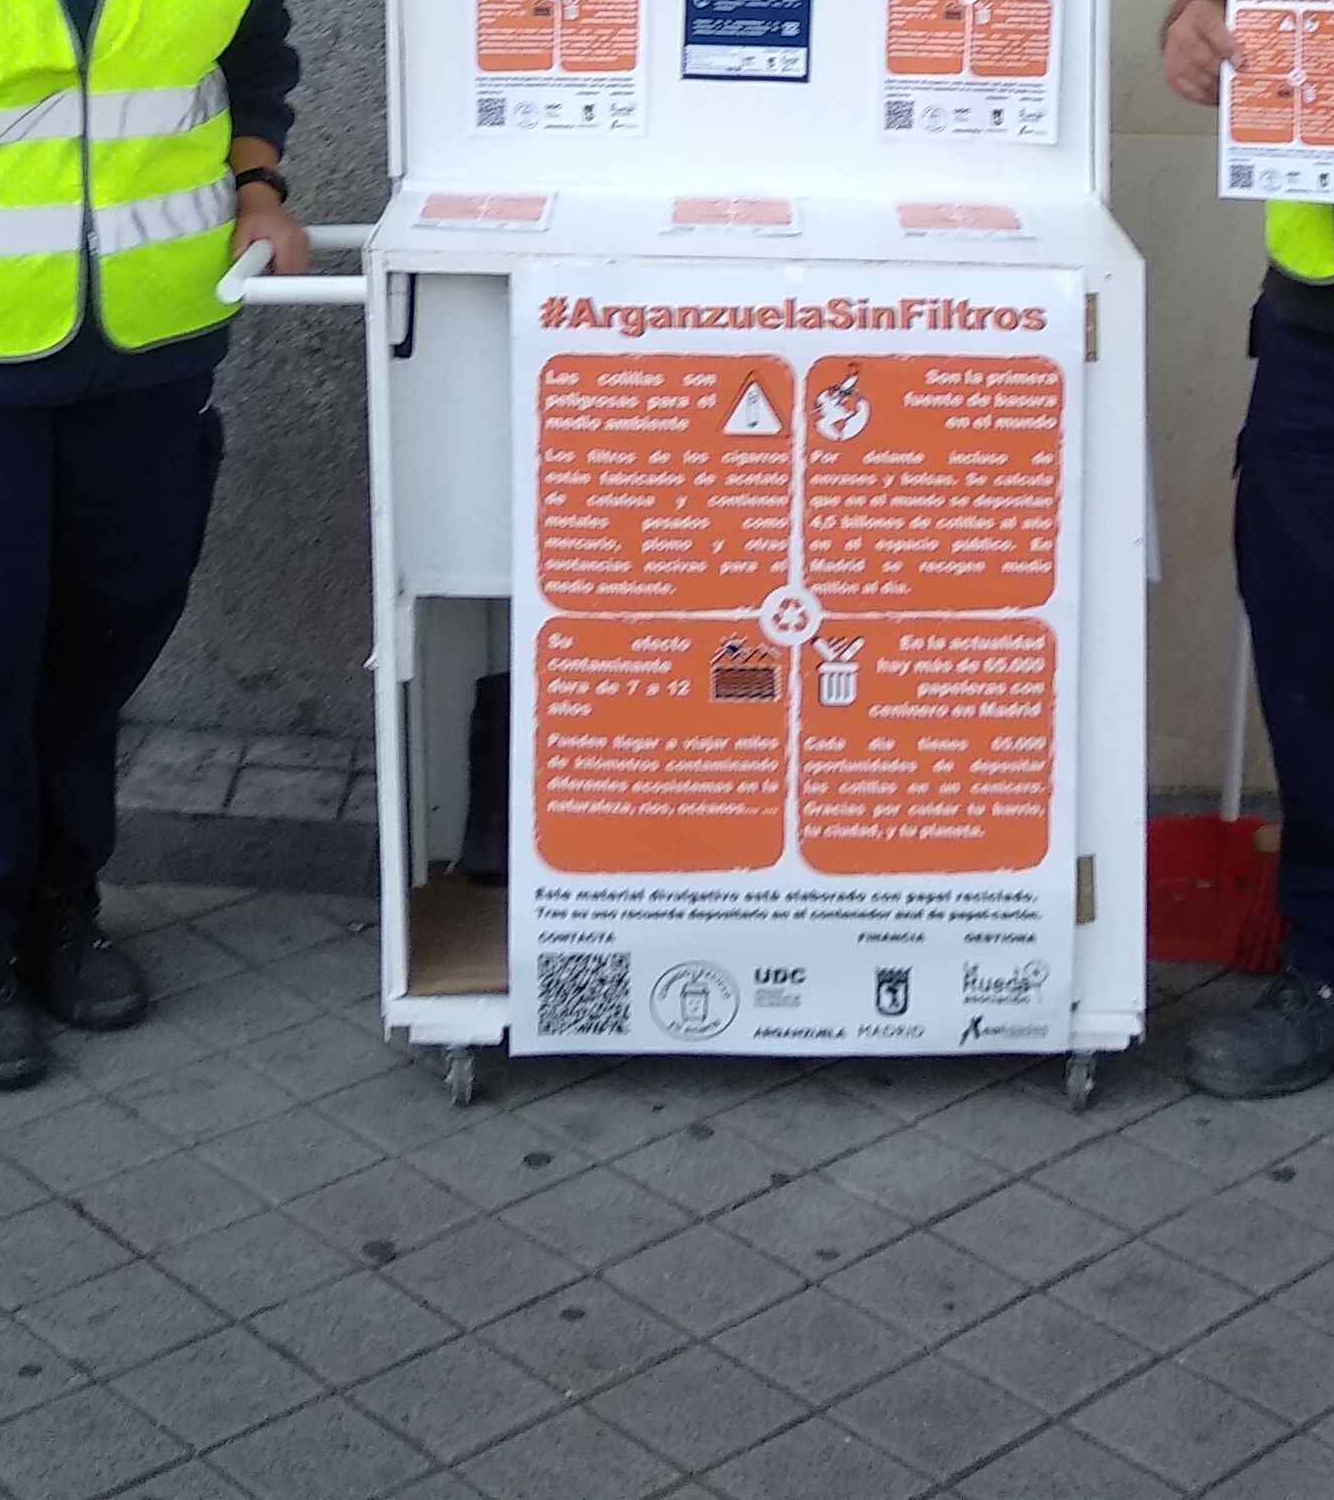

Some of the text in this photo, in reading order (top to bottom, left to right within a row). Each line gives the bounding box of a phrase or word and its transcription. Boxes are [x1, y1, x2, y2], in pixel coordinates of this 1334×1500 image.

[540, 297, 1047, 337] #ArganzuelaSinFiltros
[753, 967, 806, 986] UDC
[856, 1024, 925, 1040] MADRID
